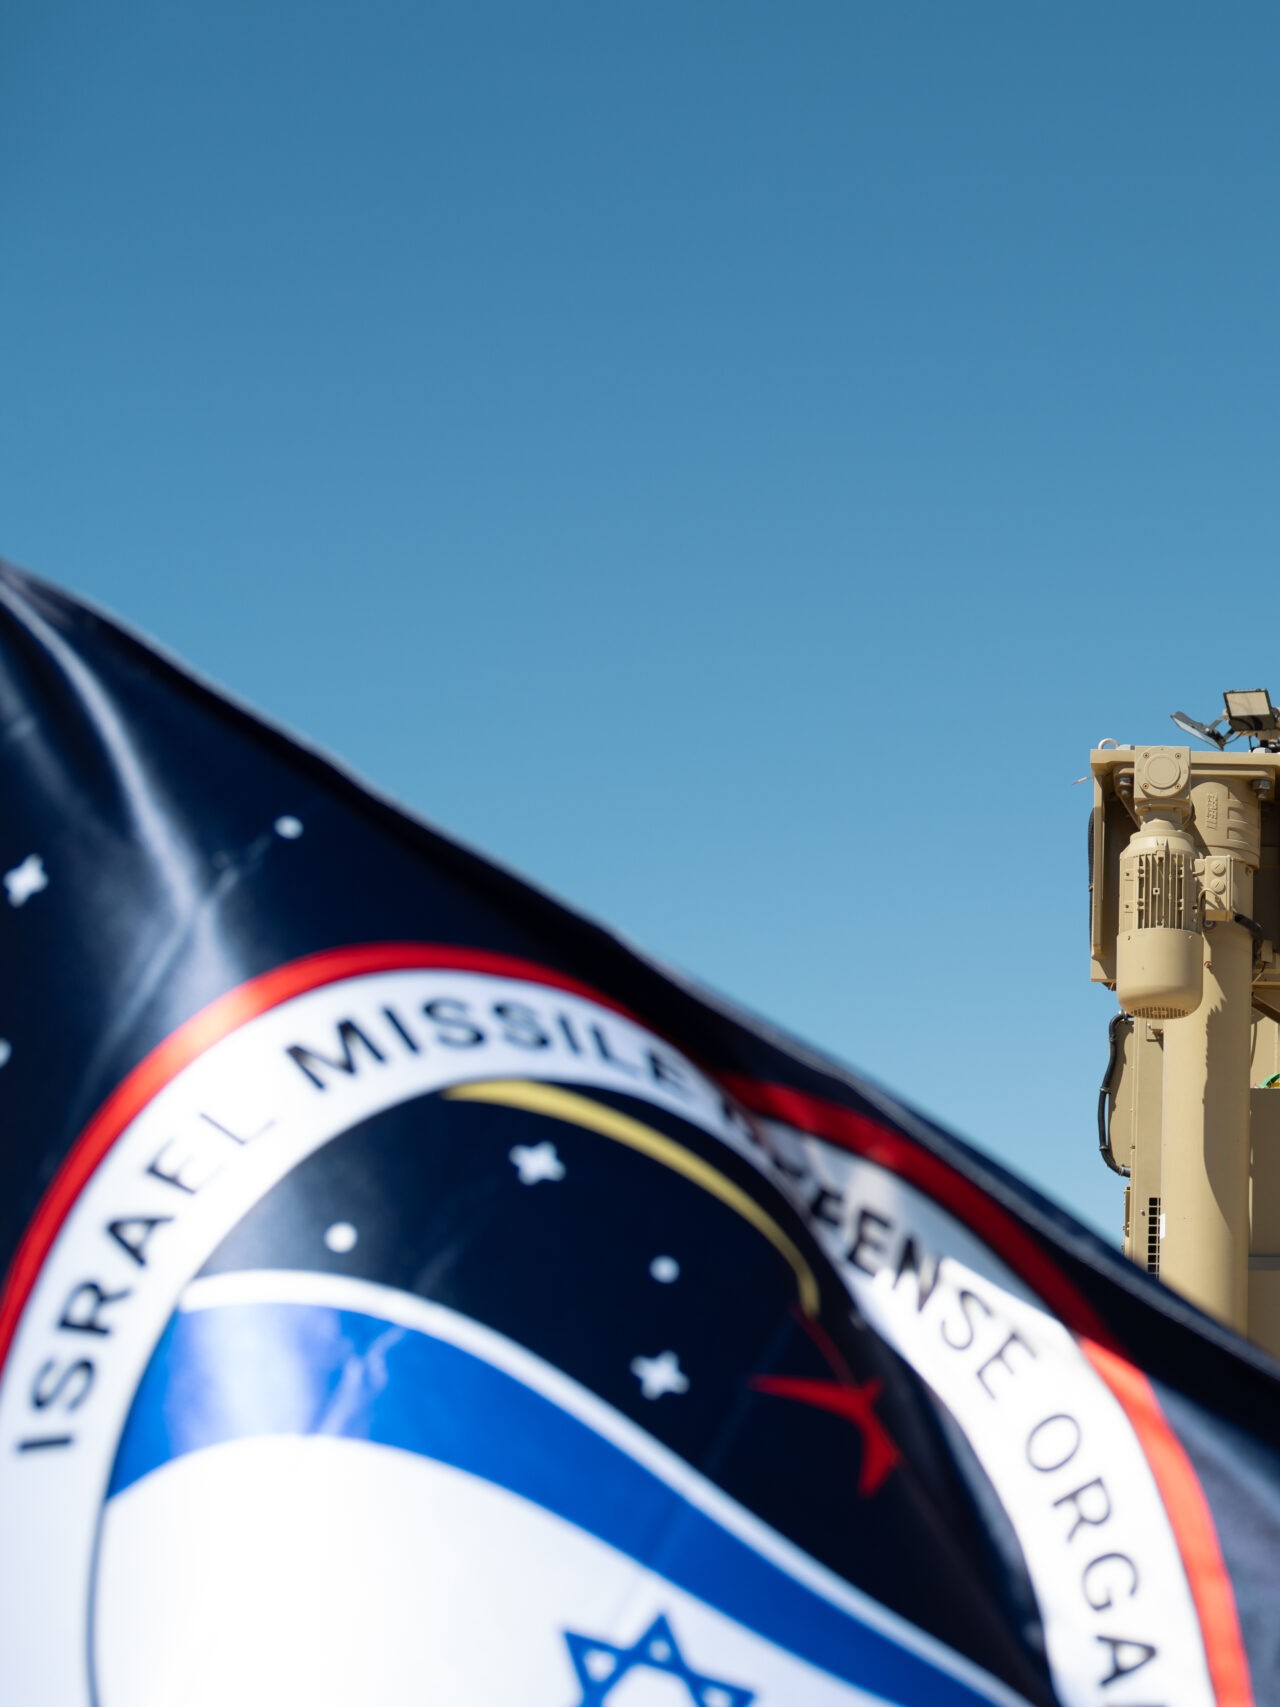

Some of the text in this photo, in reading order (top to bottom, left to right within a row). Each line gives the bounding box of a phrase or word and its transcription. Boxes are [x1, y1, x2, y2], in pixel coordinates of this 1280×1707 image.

[18, 1111, 278, 1451] ISRAEL
[285, 998, 697, 1092] MISSILE
[1025, 1412, 1167, 1707] ORGA
